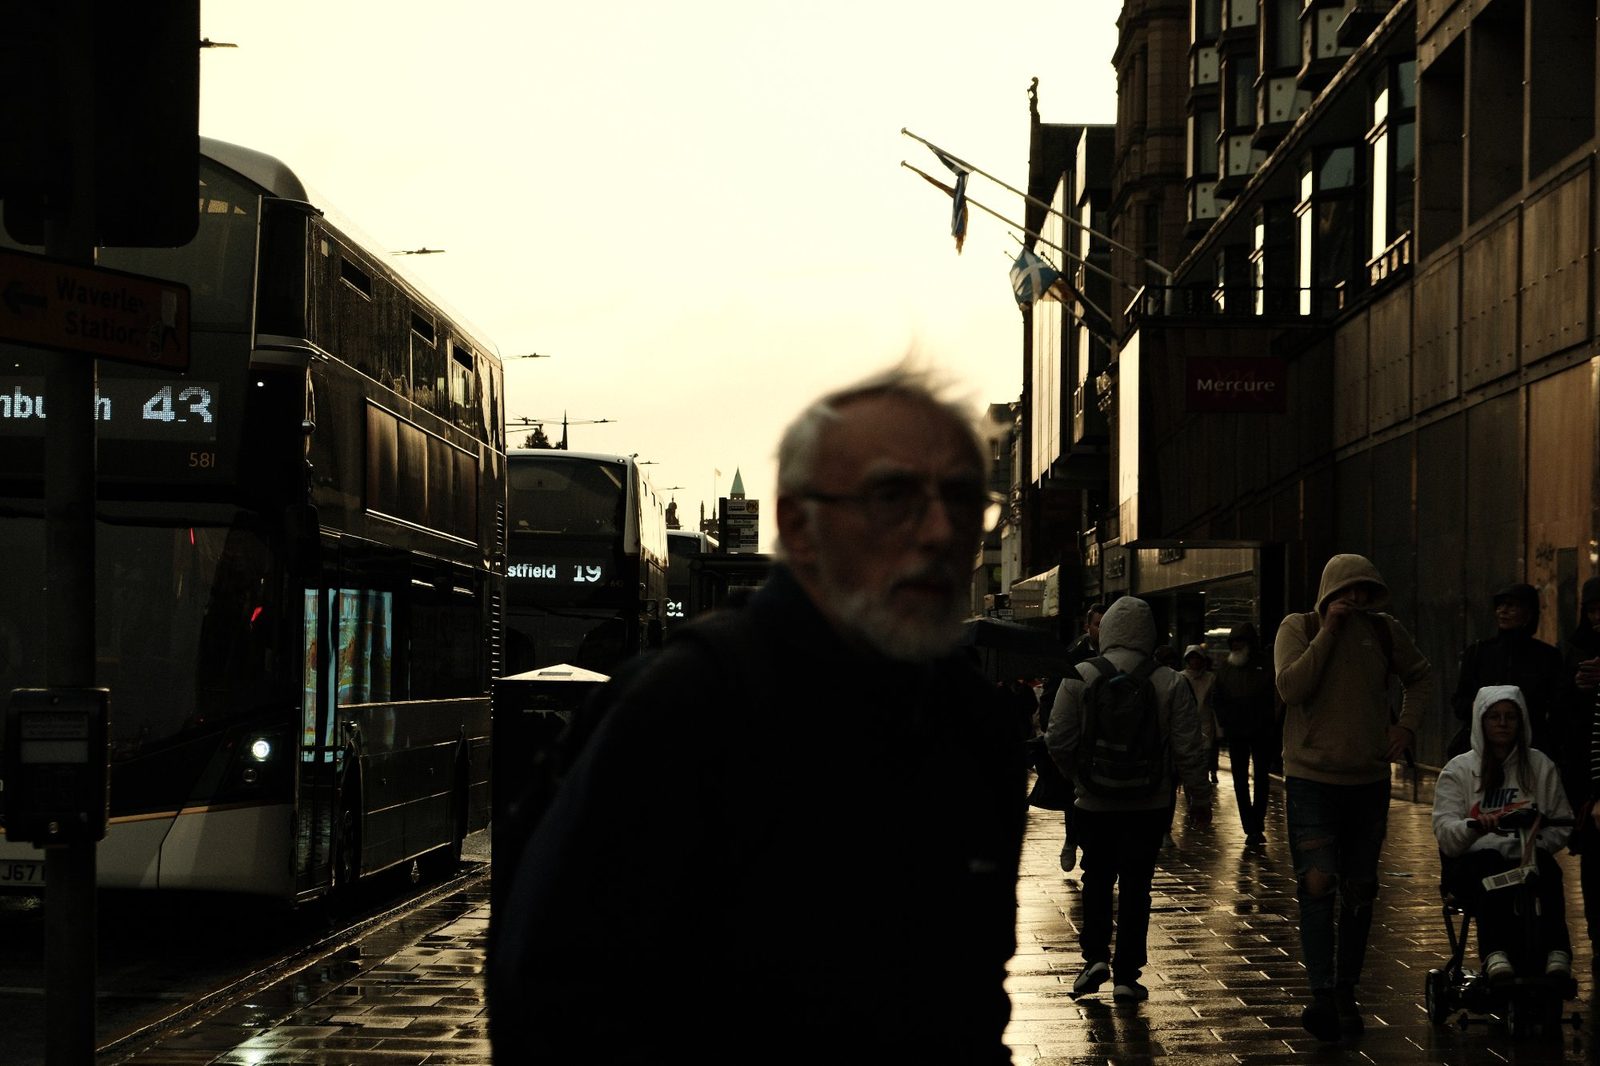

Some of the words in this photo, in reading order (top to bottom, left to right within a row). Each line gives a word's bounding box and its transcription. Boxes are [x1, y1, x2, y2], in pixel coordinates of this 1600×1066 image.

[1196, 378, 1276, 393] Mercure
[142, 385, 213, 423] 43
[188, 452, 216, 469] 581
[504, 563, 557, 579] stfield
[573, 565, 602, 583] 19
[1481, 788, 1519, 809] NIKE
[2, 864, 36, 881] J67
